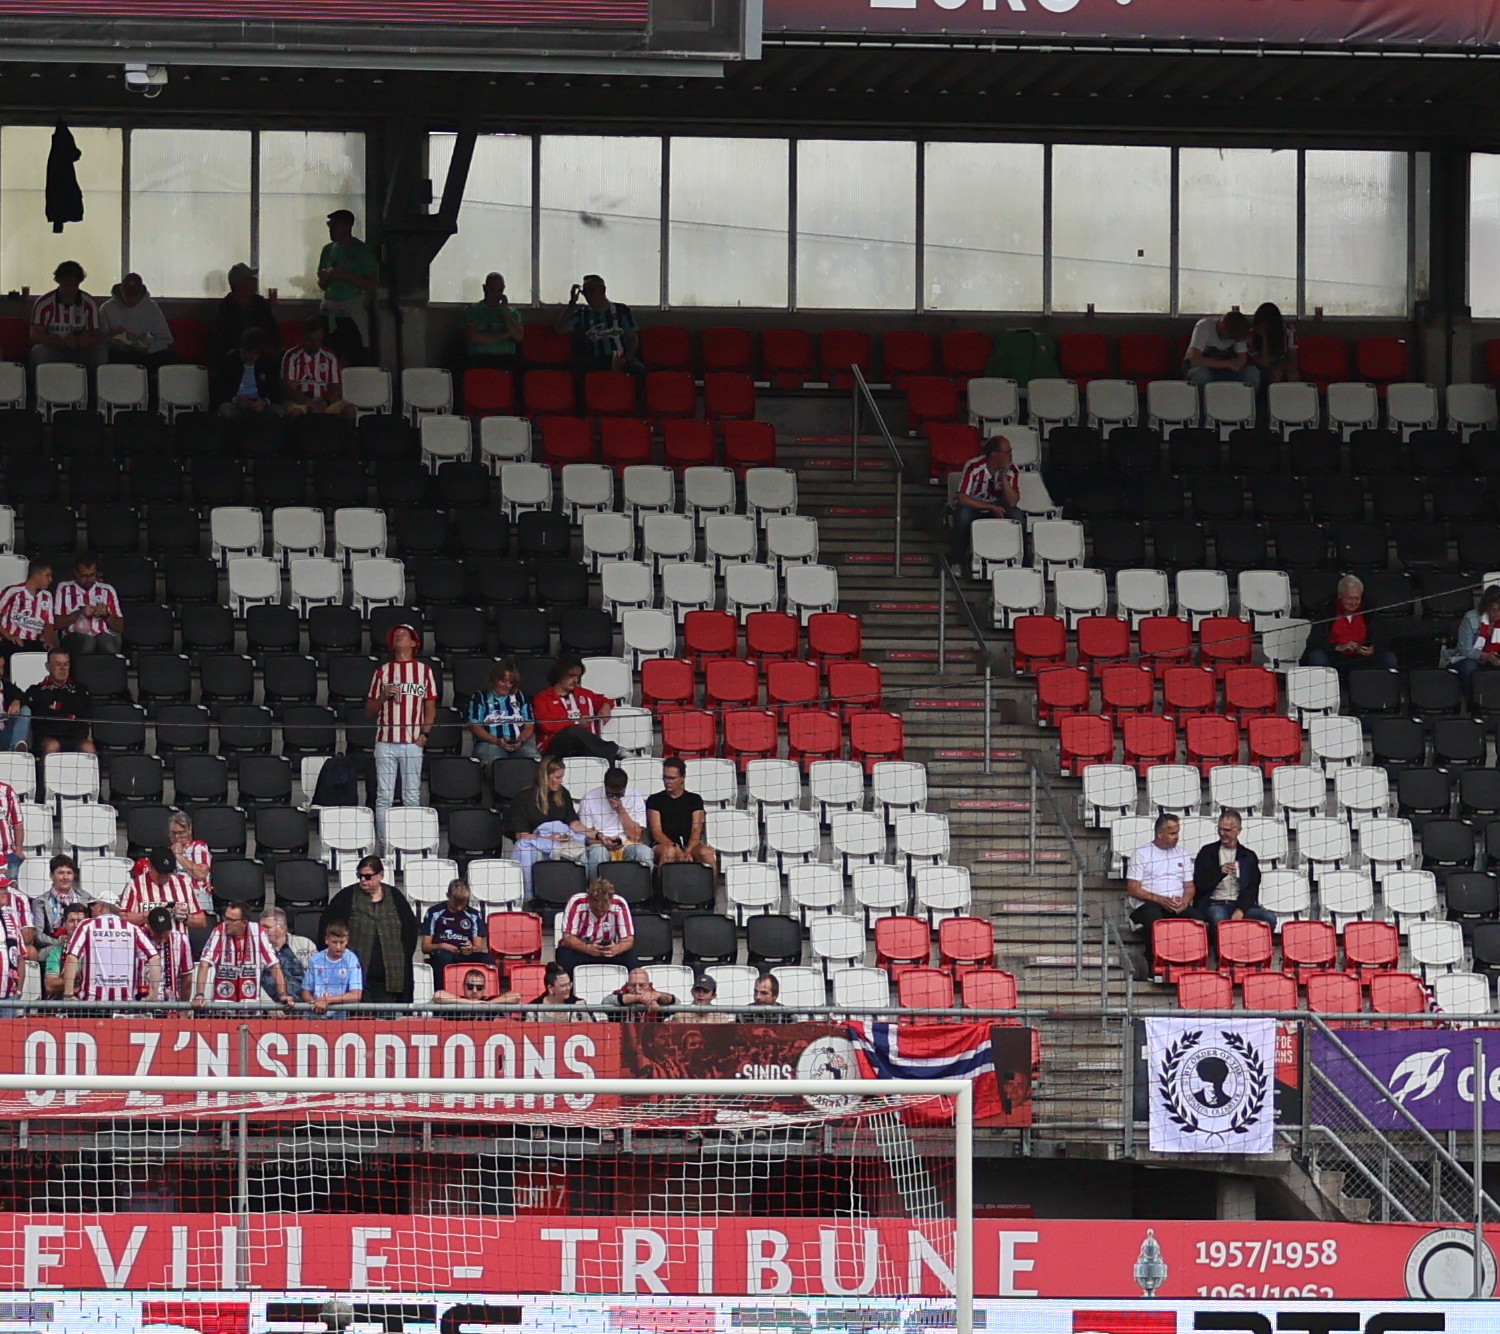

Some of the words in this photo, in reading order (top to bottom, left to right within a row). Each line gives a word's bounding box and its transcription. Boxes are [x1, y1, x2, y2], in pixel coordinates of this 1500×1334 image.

[24, 1030, 98, 1106] OP
[540, 1228, 1039, 1297] TRIBUNE
[1194, 1237, 1340, 1272] 1957/1958
